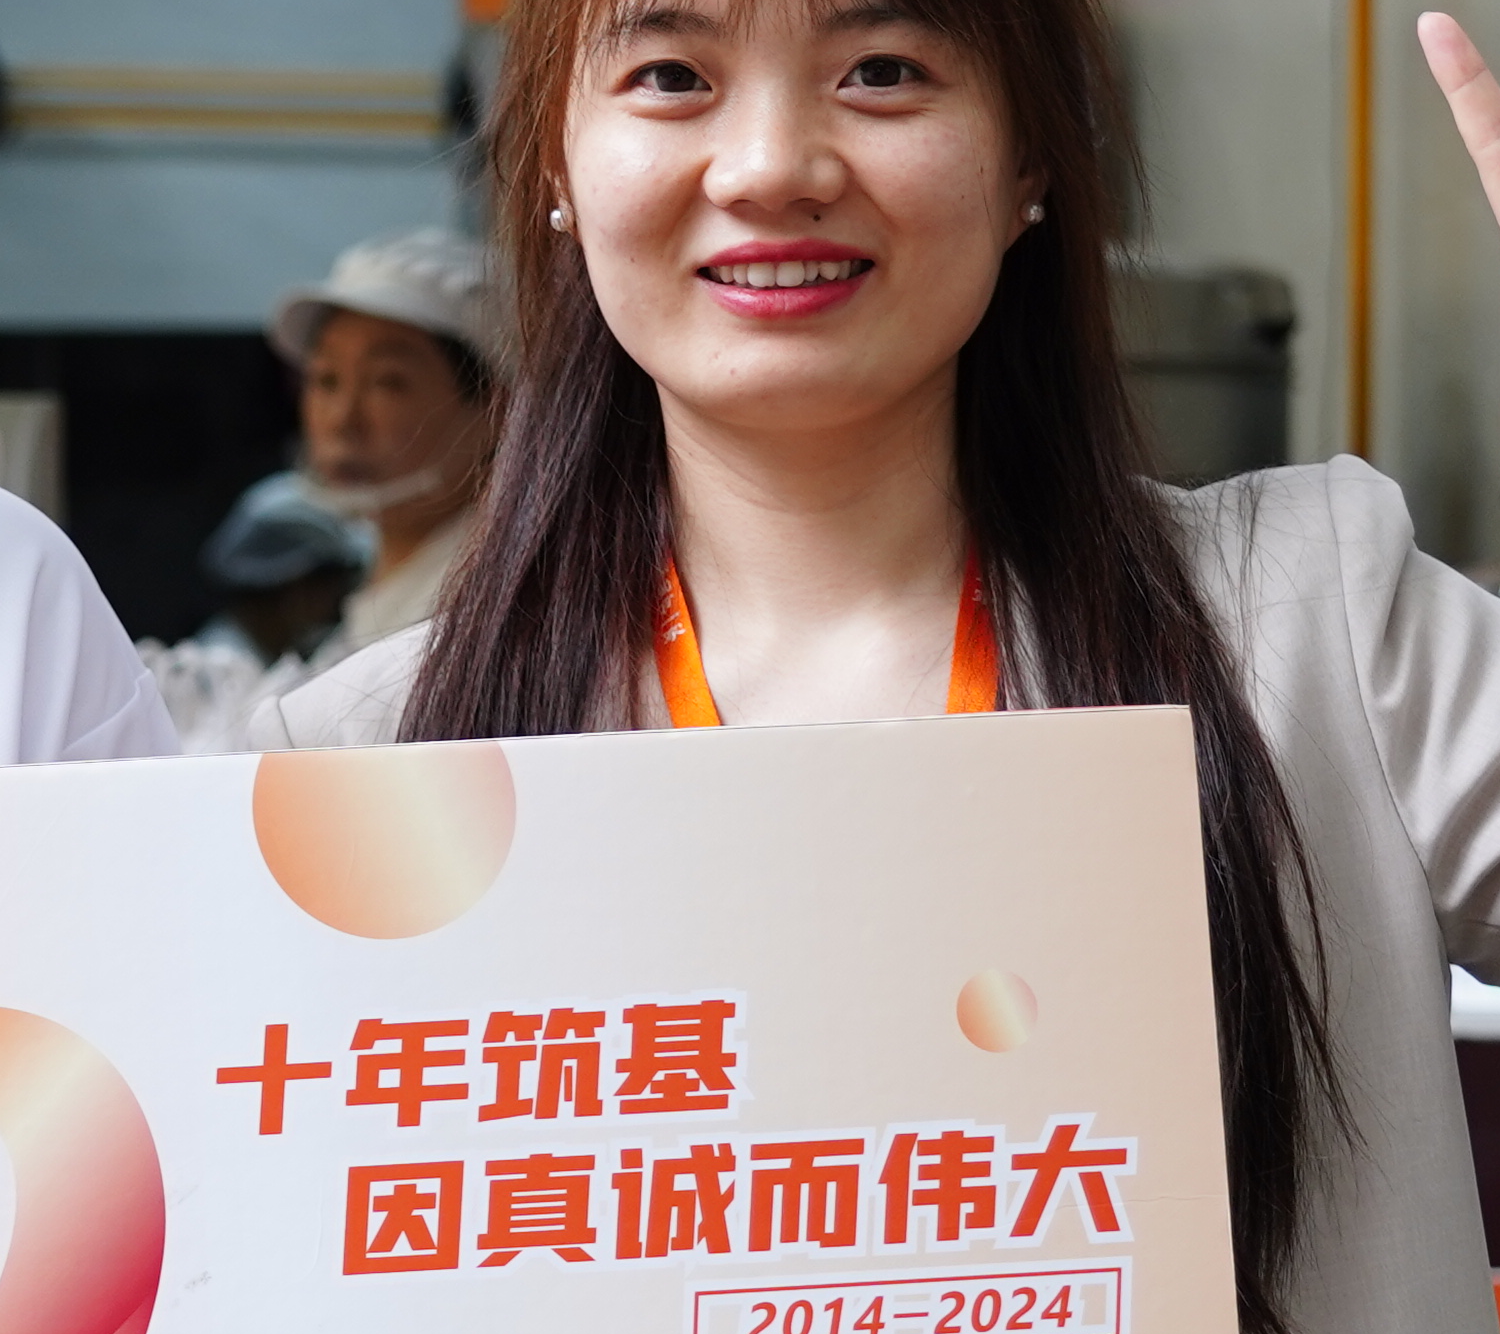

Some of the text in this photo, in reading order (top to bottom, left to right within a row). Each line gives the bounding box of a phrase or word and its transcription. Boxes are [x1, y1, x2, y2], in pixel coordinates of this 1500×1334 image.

[216, 1000, 738, 1136] 十年筑基
[343, 1124, 1127, 1276] 因真诚而伟大
